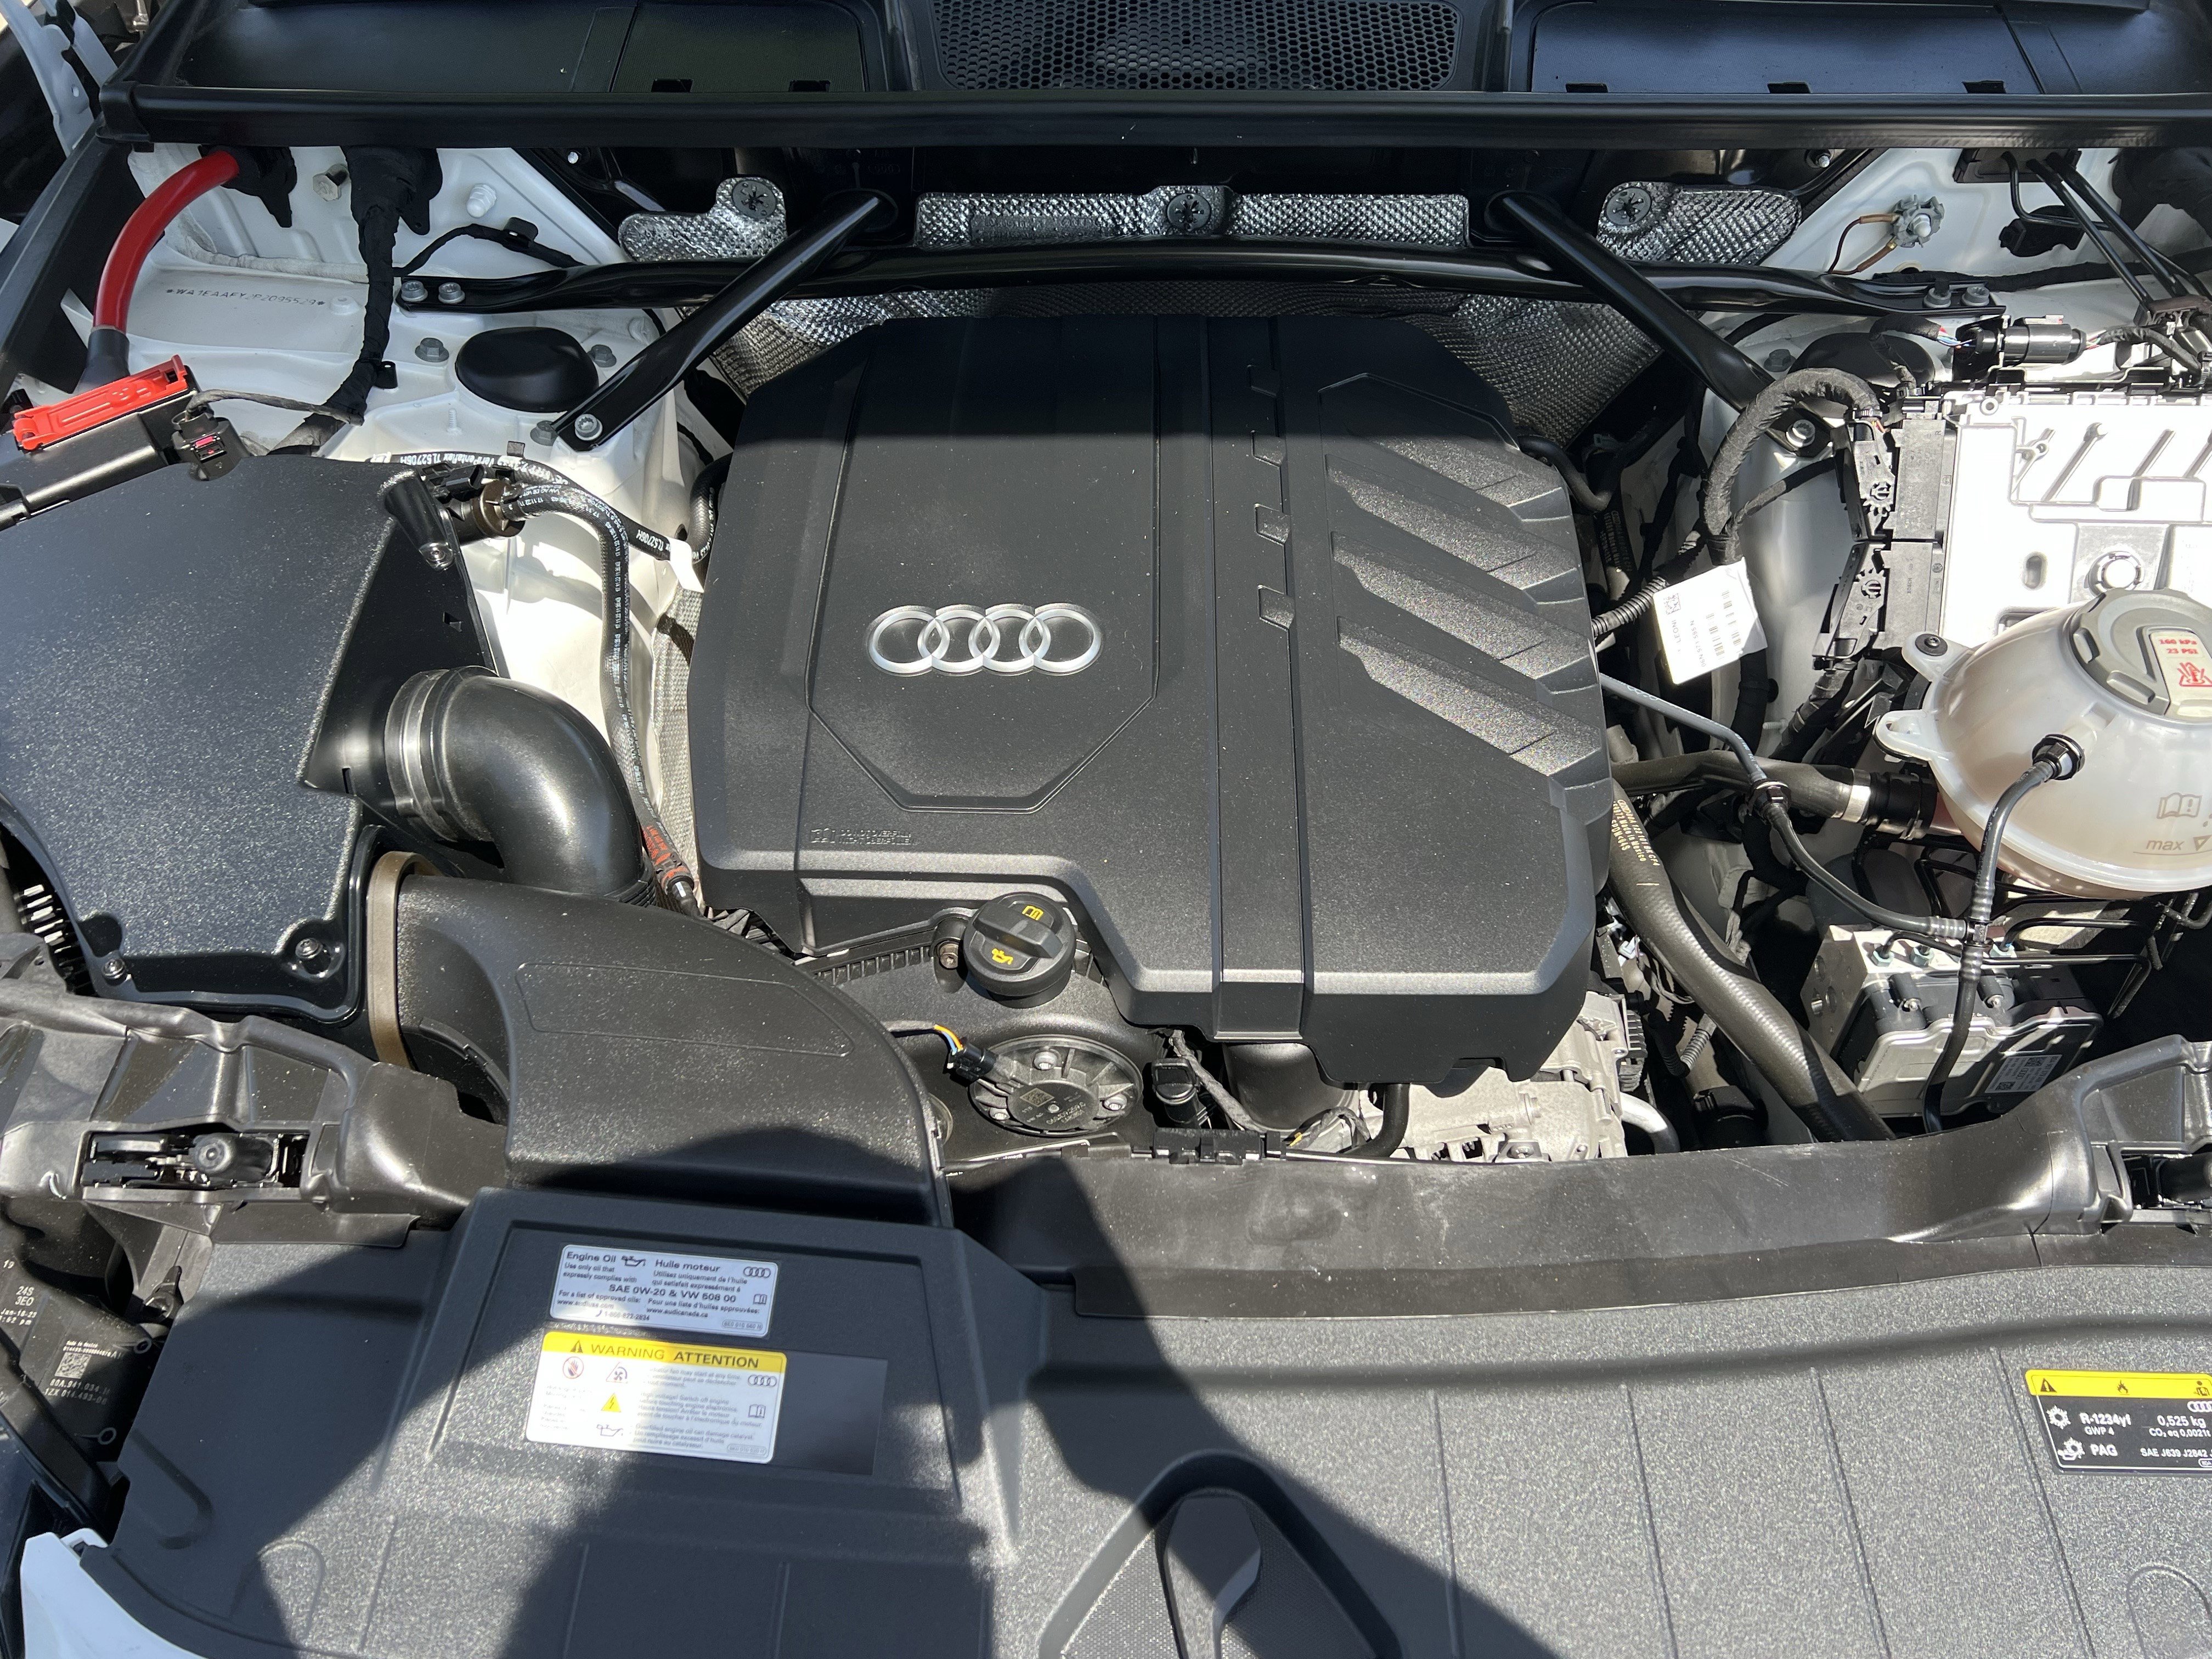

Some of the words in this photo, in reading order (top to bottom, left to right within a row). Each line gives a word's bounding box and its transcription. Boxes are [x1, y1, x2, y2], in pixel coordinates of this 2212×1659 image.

[1671, 619, 1681, 644] LEONI
[1632, 824, 1643, 834] 122
[1619, 819, 1632, 834] Made
[1630, 840, 1647, 862] Mexico
[2146, 839, 2185, 852] max
[567, 1251, 600, 1261] Engine
[603, 1254, 617, 1262] Oil
[578, 1263, 592, 1272] only
[655, 1259, 680, 1269] Huile
[683, 1262, 721, 1272] moteur
[563, 1271, 593, 1280] expressly
[593, 1273, 622, 1282] complies
[678, 1272, 717, 1282] uniquement
[664, 1280, 689, 1288] satisfait
[690, 1282, 735, 1292] expressément
[596, 1293, 627, 1302] approved
[609, 1284, 631, 1293] SAE
[633, 1286, 666, 1296] 0W-20
[668, 1289, 677, 1297] &
[681, 1290, 699, 1299] VW
[702, 1293, 720, 1302] 508
[724, 1294, 737, 1303] 00
[678, 1300, 691, 1308] liste
[646, 1307, 708, 1318] www.audicanada.ca
[591, 1344, 665, 1361] WARNING
[673, 1351, 759, 1370] ATTENTION
[2079, 1412, 2131, 1427] R-1234yf
[2157, 1414, 2189, 1427] 0,525
[2190, 1415, 2207, 1429] kg
[2084, 1426, 2107, 1435] GWP
[2108, 1426, 2115, 1436] 4
[2167, 1429, 2180, 1438] eq
[2090, 1443, 2118, 1457] PAG
[2140, 1447, 2160, 1457] SAE
[2161, 1448, 2181, 1458] J639
